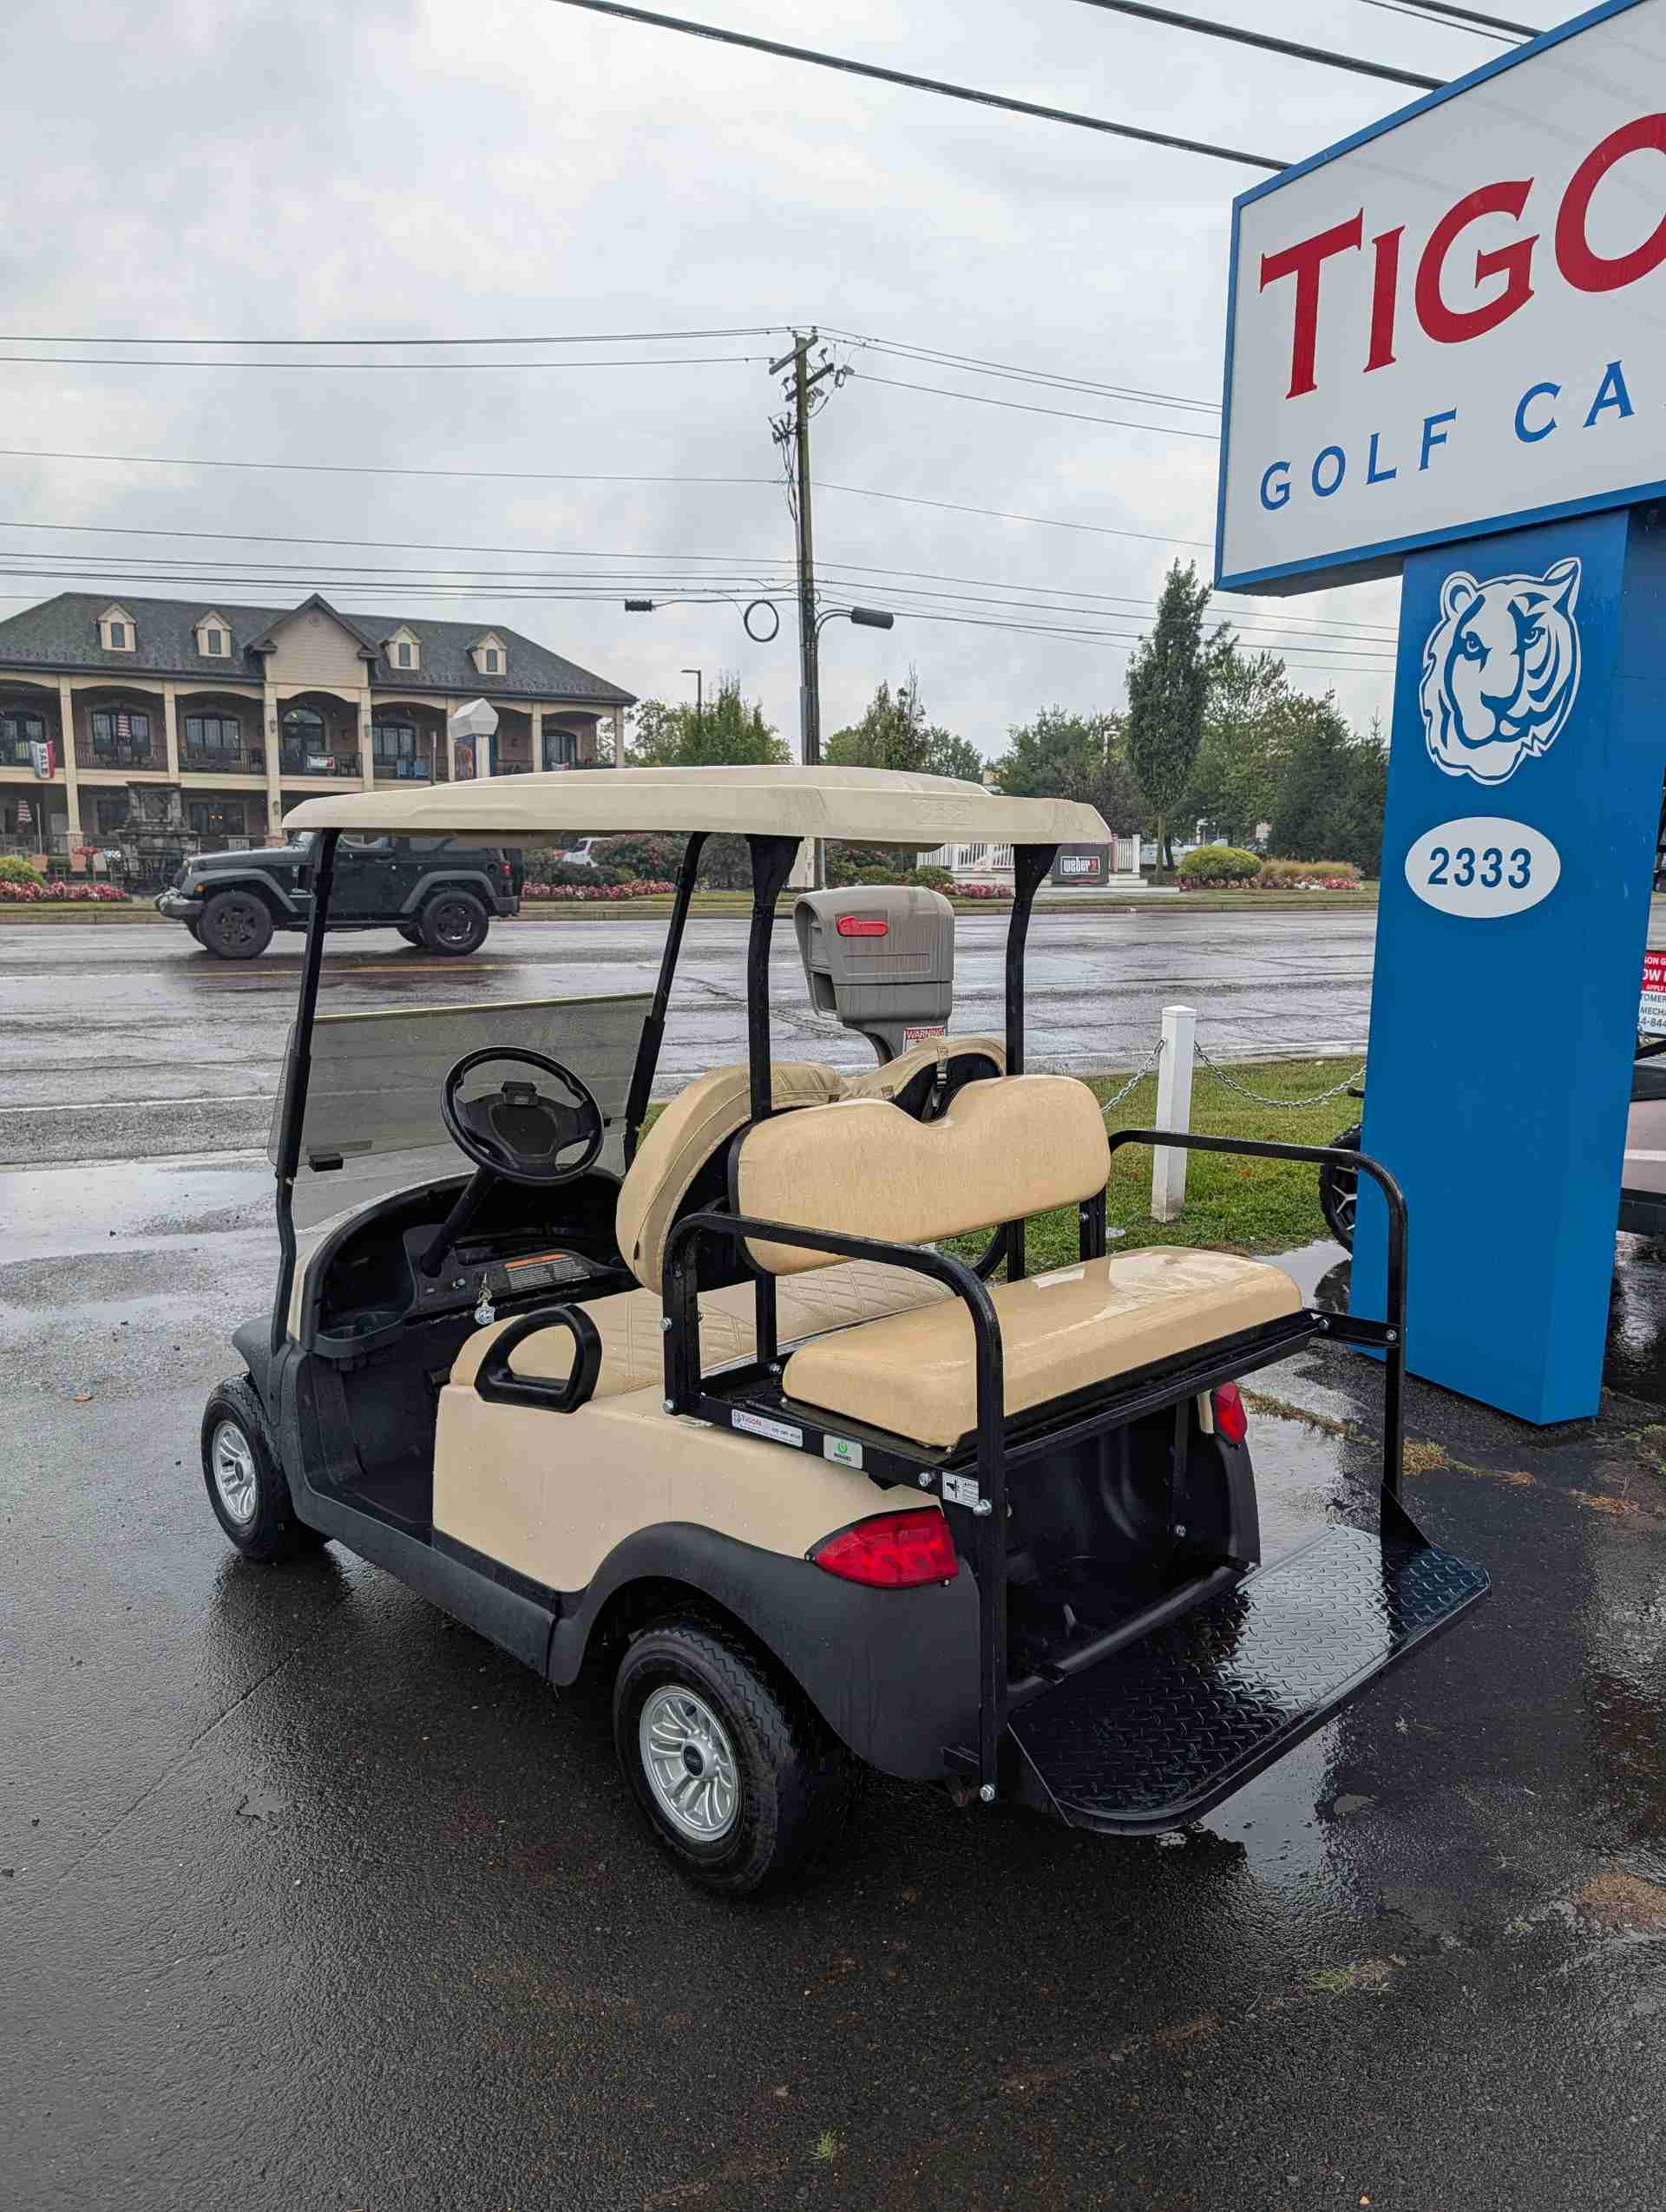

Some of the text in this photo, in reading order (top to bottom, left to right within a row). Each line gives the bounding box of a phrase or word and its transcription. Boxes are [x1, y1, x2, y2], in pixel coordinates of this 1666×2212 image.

[1259, 113, 1666, 399] TIGO
[1260, 407, 1457, 510] GOLF
[1063, 856, 1091, 873] weber
[1427, 847, 1532, 889] 2333
